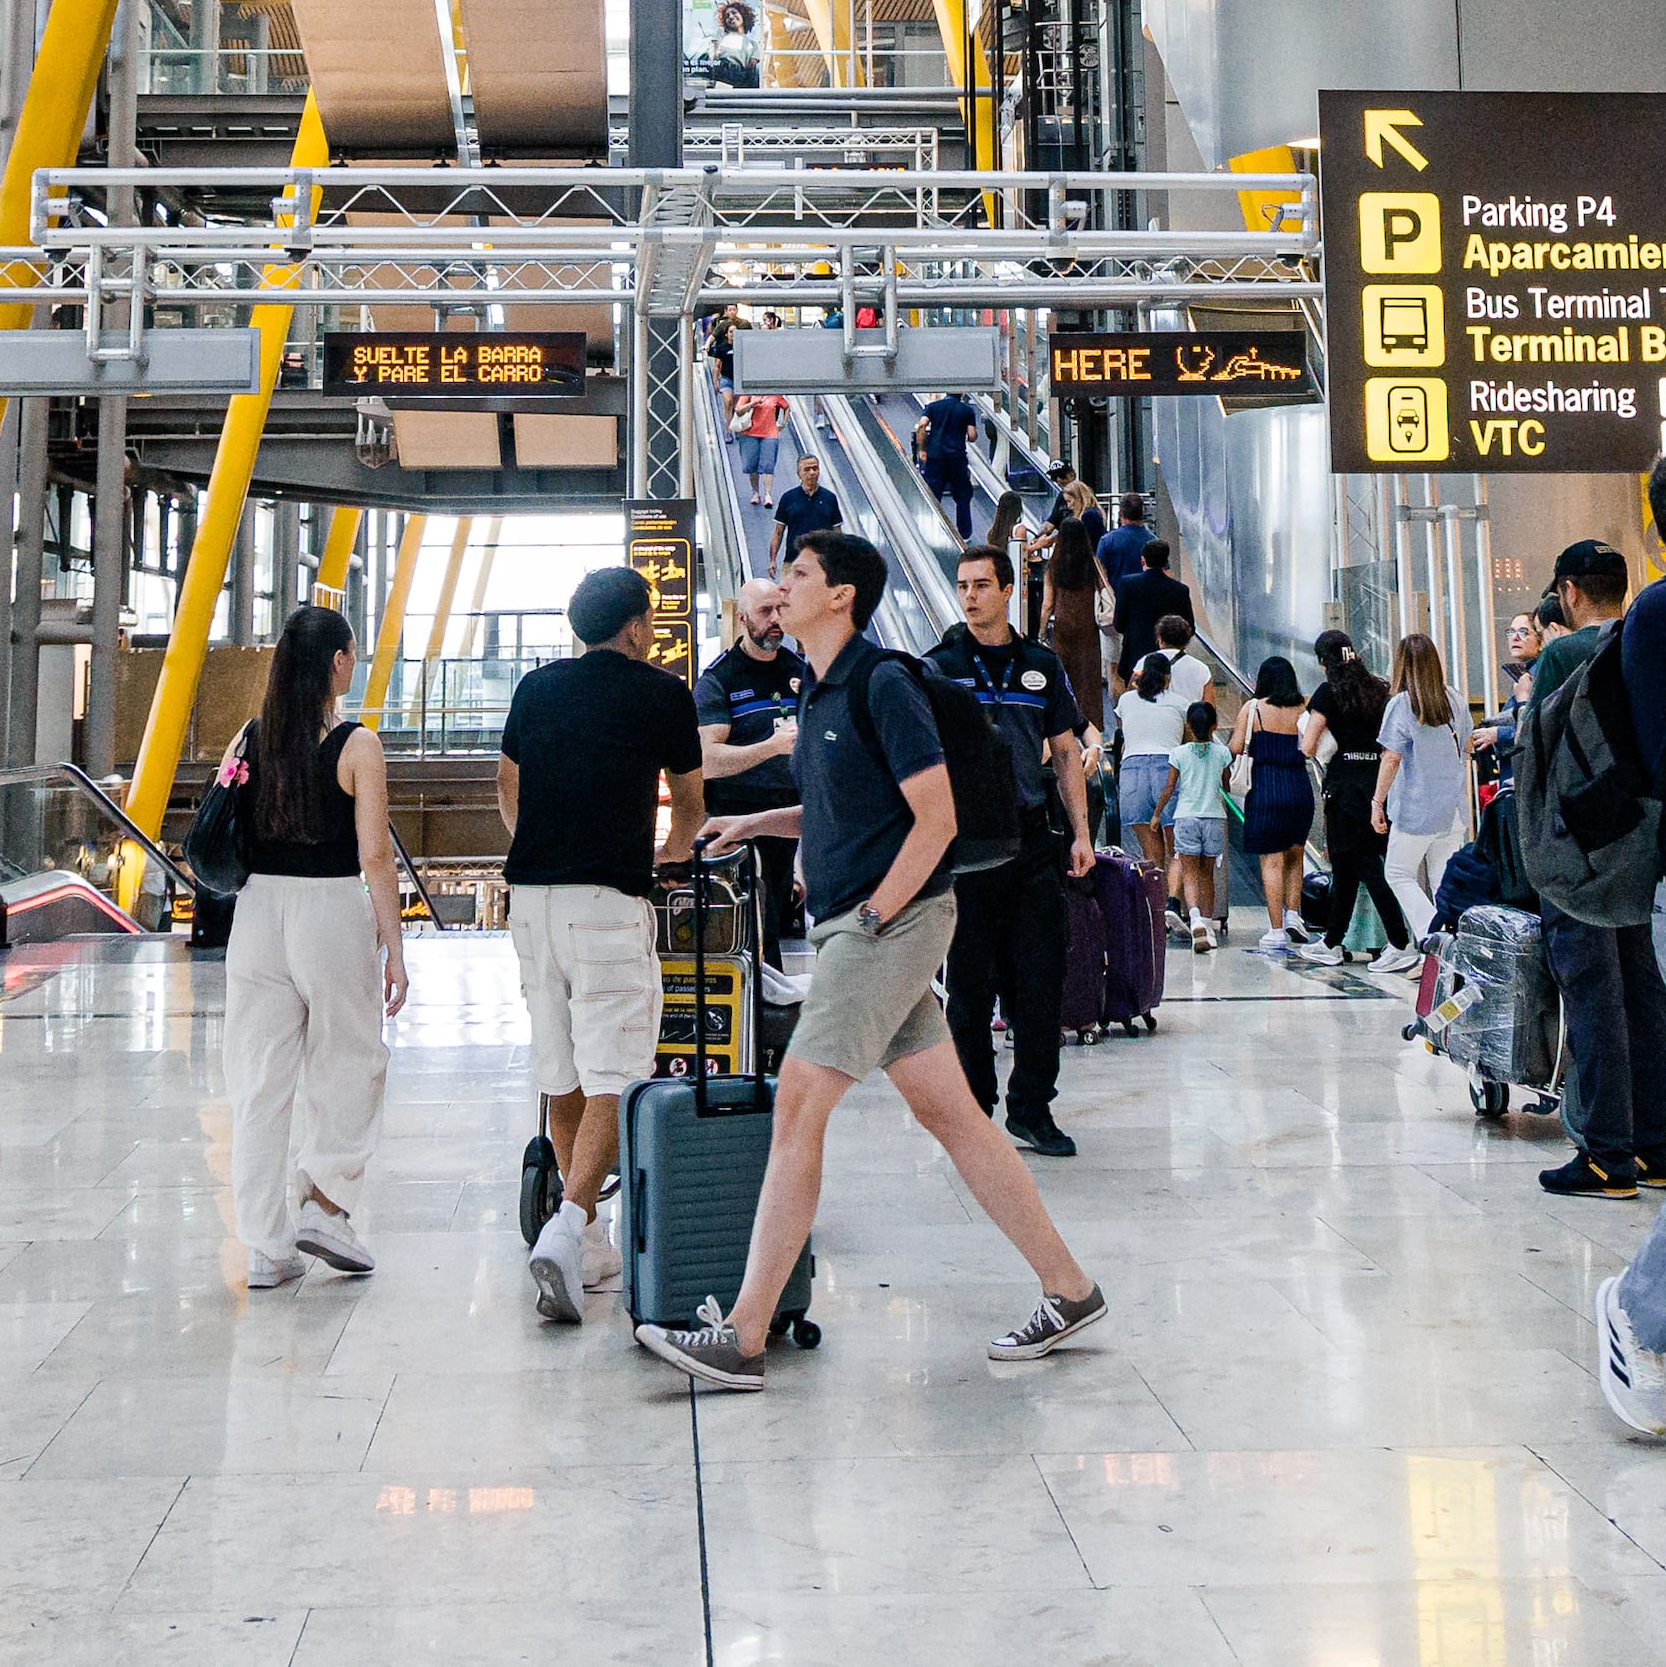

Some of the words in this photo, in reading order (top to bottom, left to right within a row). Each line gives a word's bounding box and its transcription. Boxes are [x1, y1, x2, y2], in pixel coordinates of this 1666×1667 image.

[1463, 194, 1569, 234] Parking
[1577, 195, 1617, 227] P4
[1466, 286, 1520, 319] Bus
[1527, 285, 1651, 319] Terminal
[353, 345, 430, 365] SUELTE
[440, 346, 469, 365] LA
[477, 345, 543, 365] BARRA
[1465, 325, 1630, 363] Terminal
[353, 366, 368, 383] Y
[378, 365, 430, 383] PARE
[440, 365, 469, 383] EL
[477, 365, 543, 383] CARRO
[1054, 348, 1152, 382] HERE
[1470, 379, 1637, 418] Ridesharing
[1468, 419, 1546, 457] VTC
